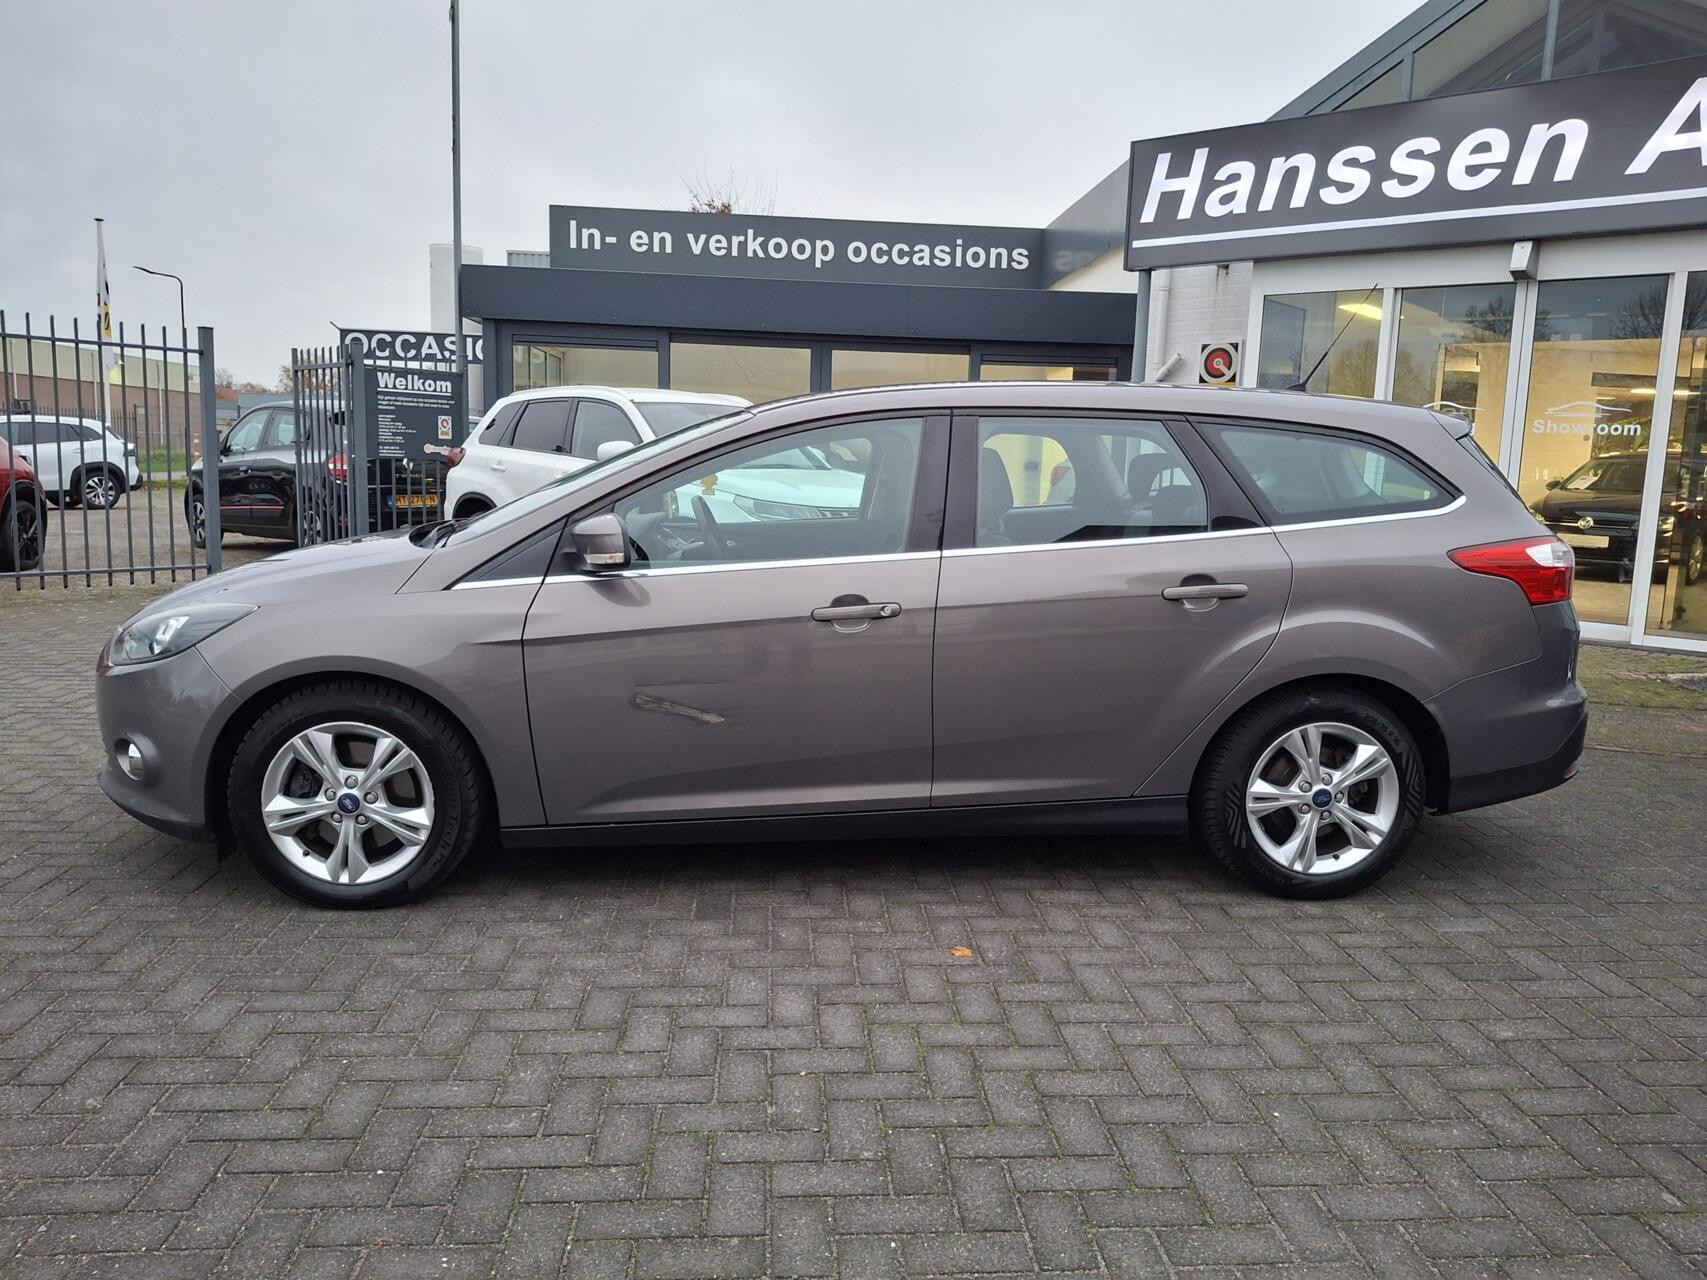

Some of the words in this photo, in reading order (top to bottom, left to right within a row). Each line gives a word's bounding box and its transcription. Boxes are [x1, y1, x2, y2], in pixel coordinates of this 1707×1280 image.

[1140, 117, 1589, 223] Hanssen
[569, 219, 617, 250] In-
[629, 228, 673, 254] en
[686, 229, 836, 268] verkoop
[847, 239, 1030, 270] occasions
[377, 371, 452, 393] Welkom
[1532, 420, 1642, 436] Showroom
